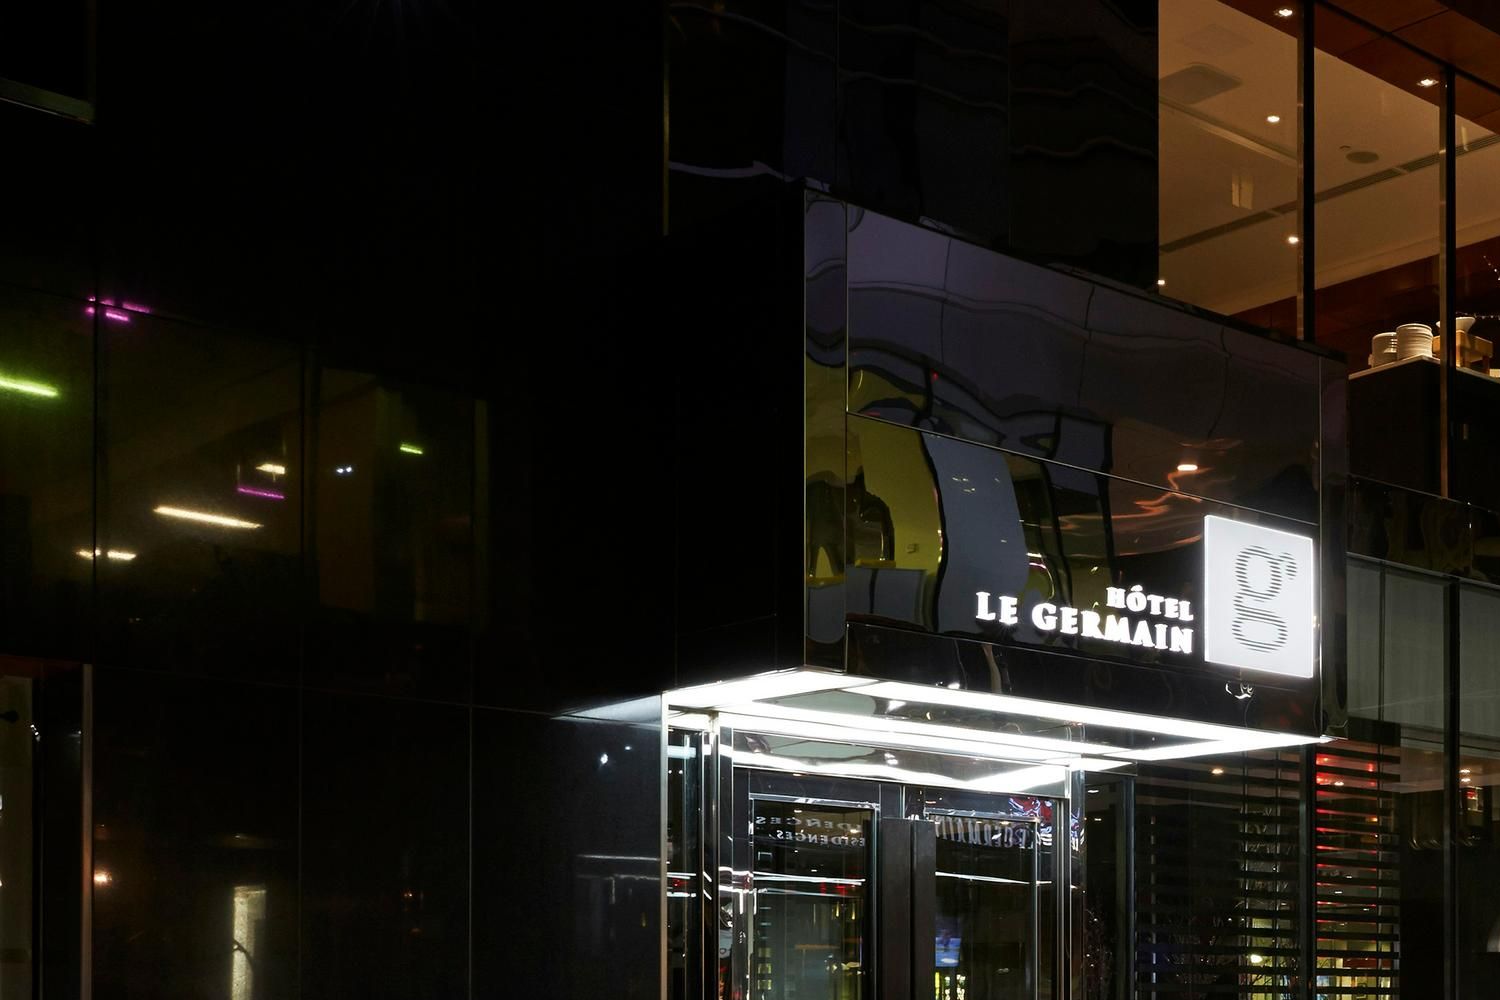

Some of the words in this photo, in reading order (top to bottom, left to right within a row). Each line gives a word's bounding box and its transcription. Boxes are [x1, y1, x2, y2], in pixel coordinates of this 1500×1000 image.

[975, 591, 1018, 625] LE
[1031, 603, 1194, 654] GERMAIN
[1106, 584, 1194, 621] HÔTEL
